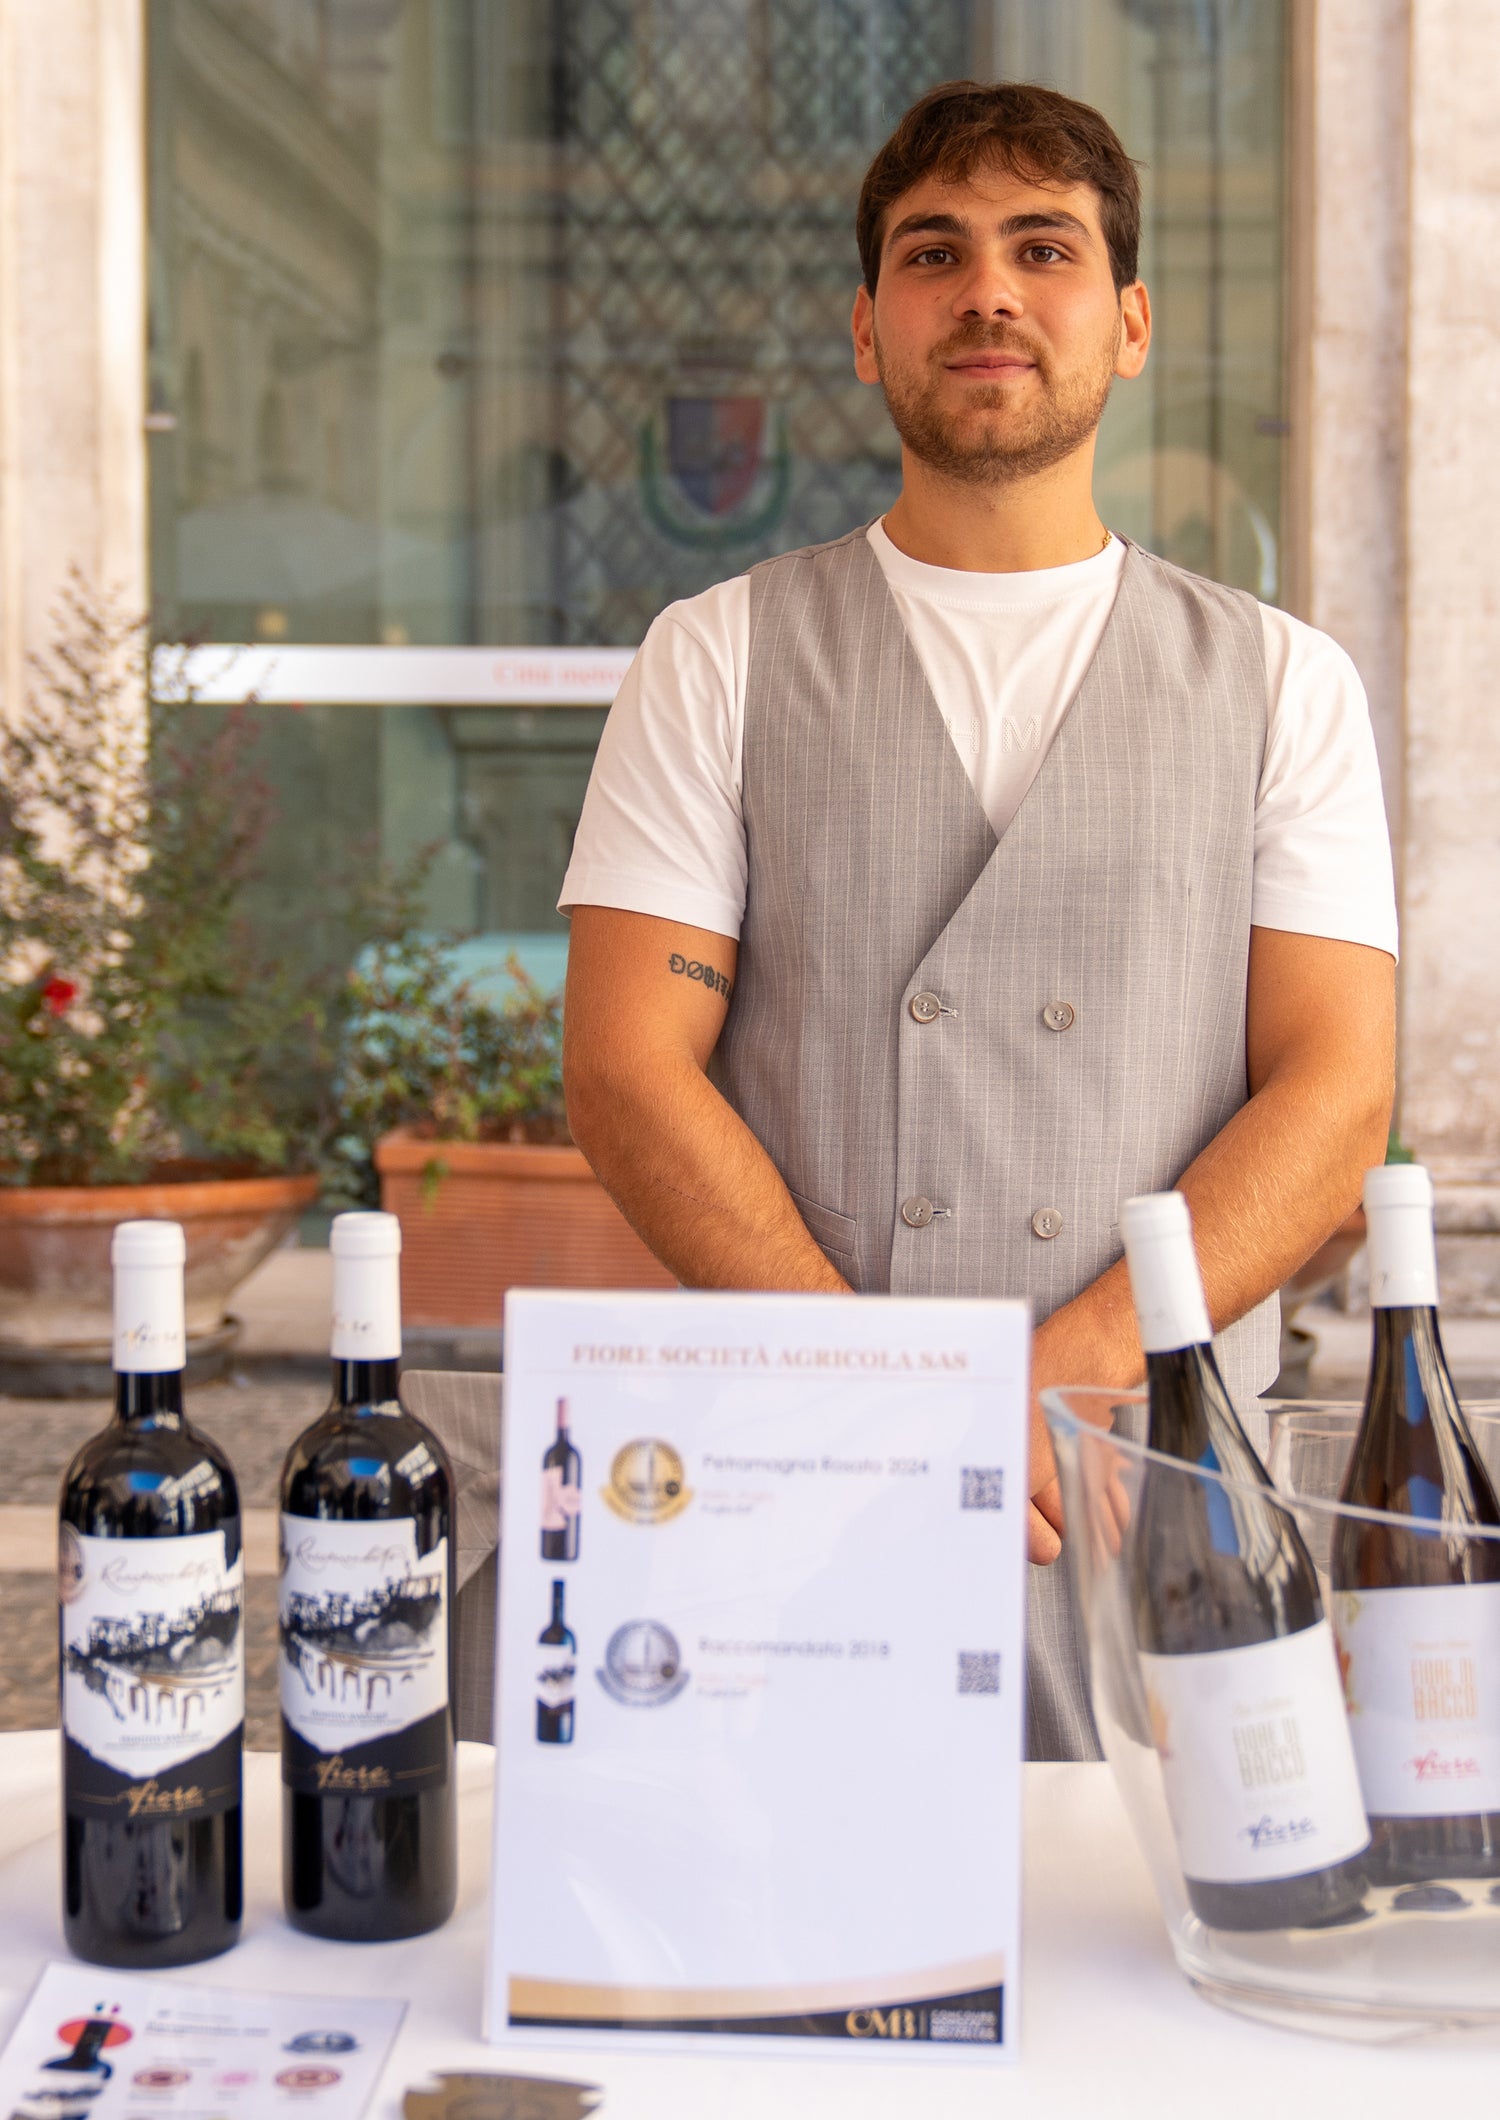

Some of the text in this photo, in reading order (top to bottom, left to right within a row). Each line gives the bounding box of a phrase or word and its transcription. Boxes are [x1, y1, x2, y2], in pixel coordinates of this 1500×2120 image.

[572, 1341, 968, 1372] FIORE SOCIETÀ AGRICOLA SAS
[888, 1456, 930, 1475] 2024
[698, 1636, 843, 1659] Raccomandato
